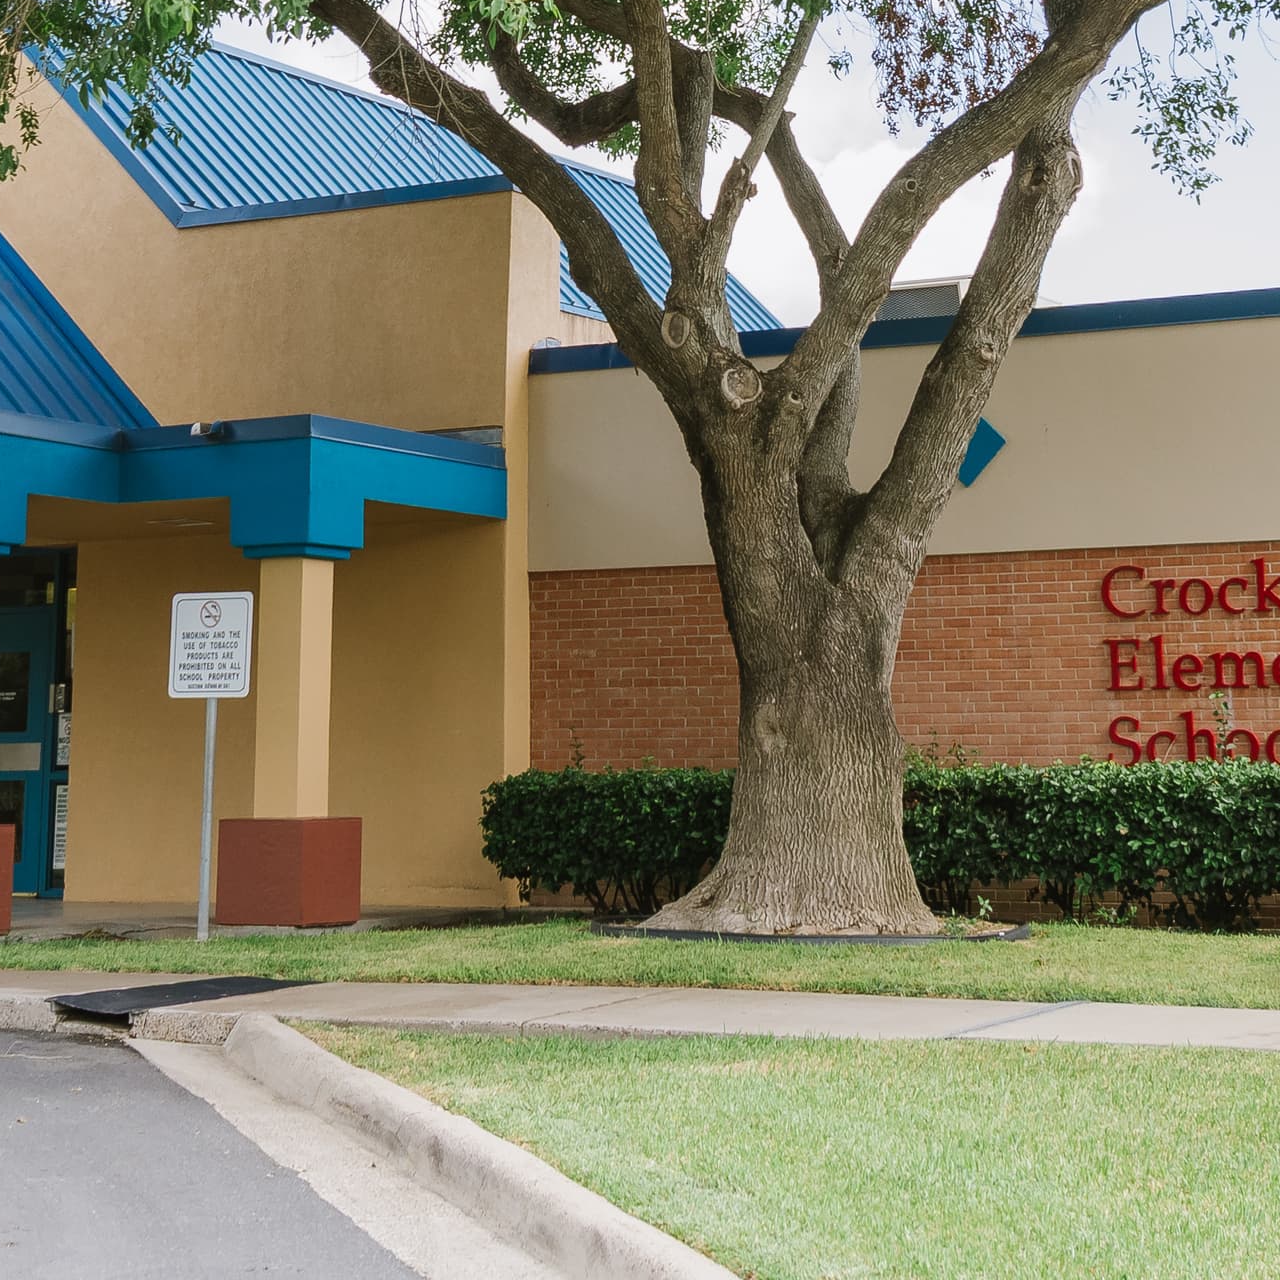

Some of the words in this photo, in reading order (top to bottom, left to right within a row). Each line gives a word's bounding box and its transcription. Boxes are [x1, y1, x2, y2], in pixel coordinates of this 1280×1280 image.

[181, 631, 210, 640] SMOKING
[213, 631, 226, 639] AND
[229, 630, 241, 638] THE
[183, 642, 195, 650] USE
[210, 641, 239, 649] TOBACCO
[186, 652, 218, 660] PRODUCTS
[178, 663, 215, 671] PROHIBITED
[218, 662, 227, 670] ON
[230, 662, 241, 670] ALL
[179, 673, 203, 681] SCHOOL
[208, 672, 240, 680] PROPERTY
